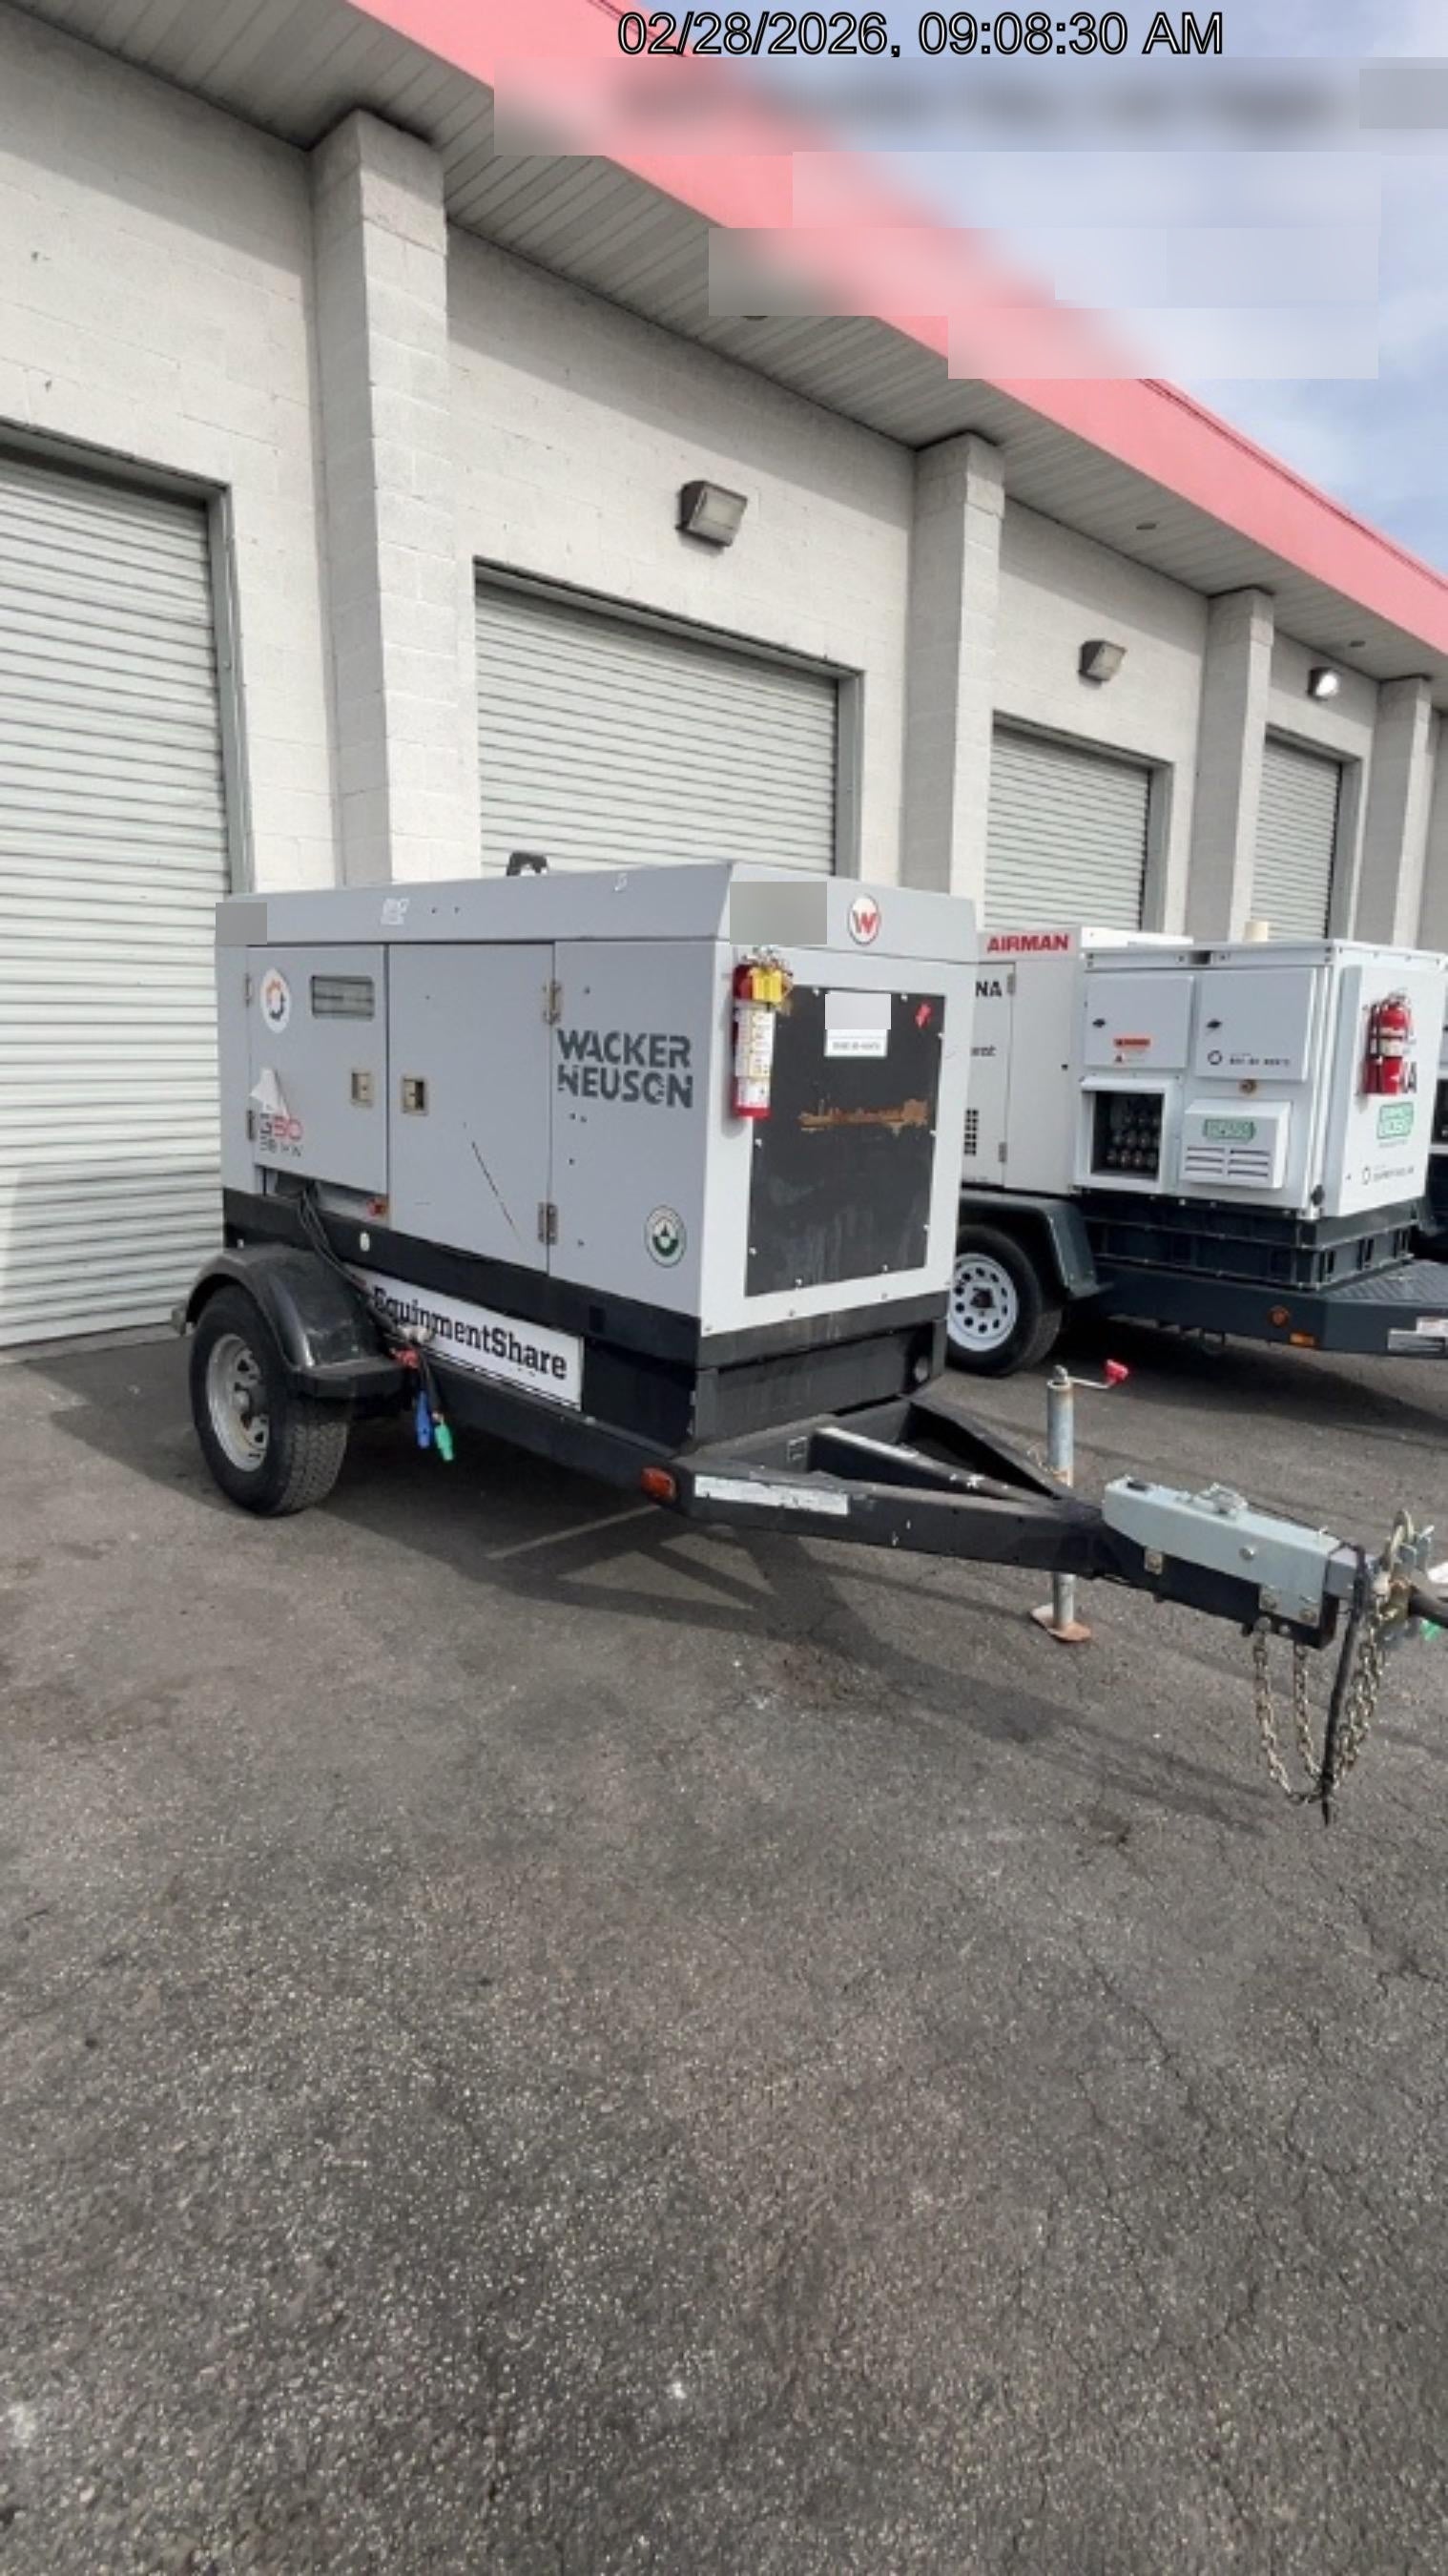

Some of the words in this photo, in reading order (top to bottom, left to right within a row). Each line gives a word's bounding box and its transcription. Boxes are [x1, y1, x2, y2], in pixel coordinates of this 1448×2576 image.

[986, 934, 1069, 952] AIRMAN
[557, 1028, 692, 1069] WACKER
[557, 1064, 693, 1110] NEUSON
